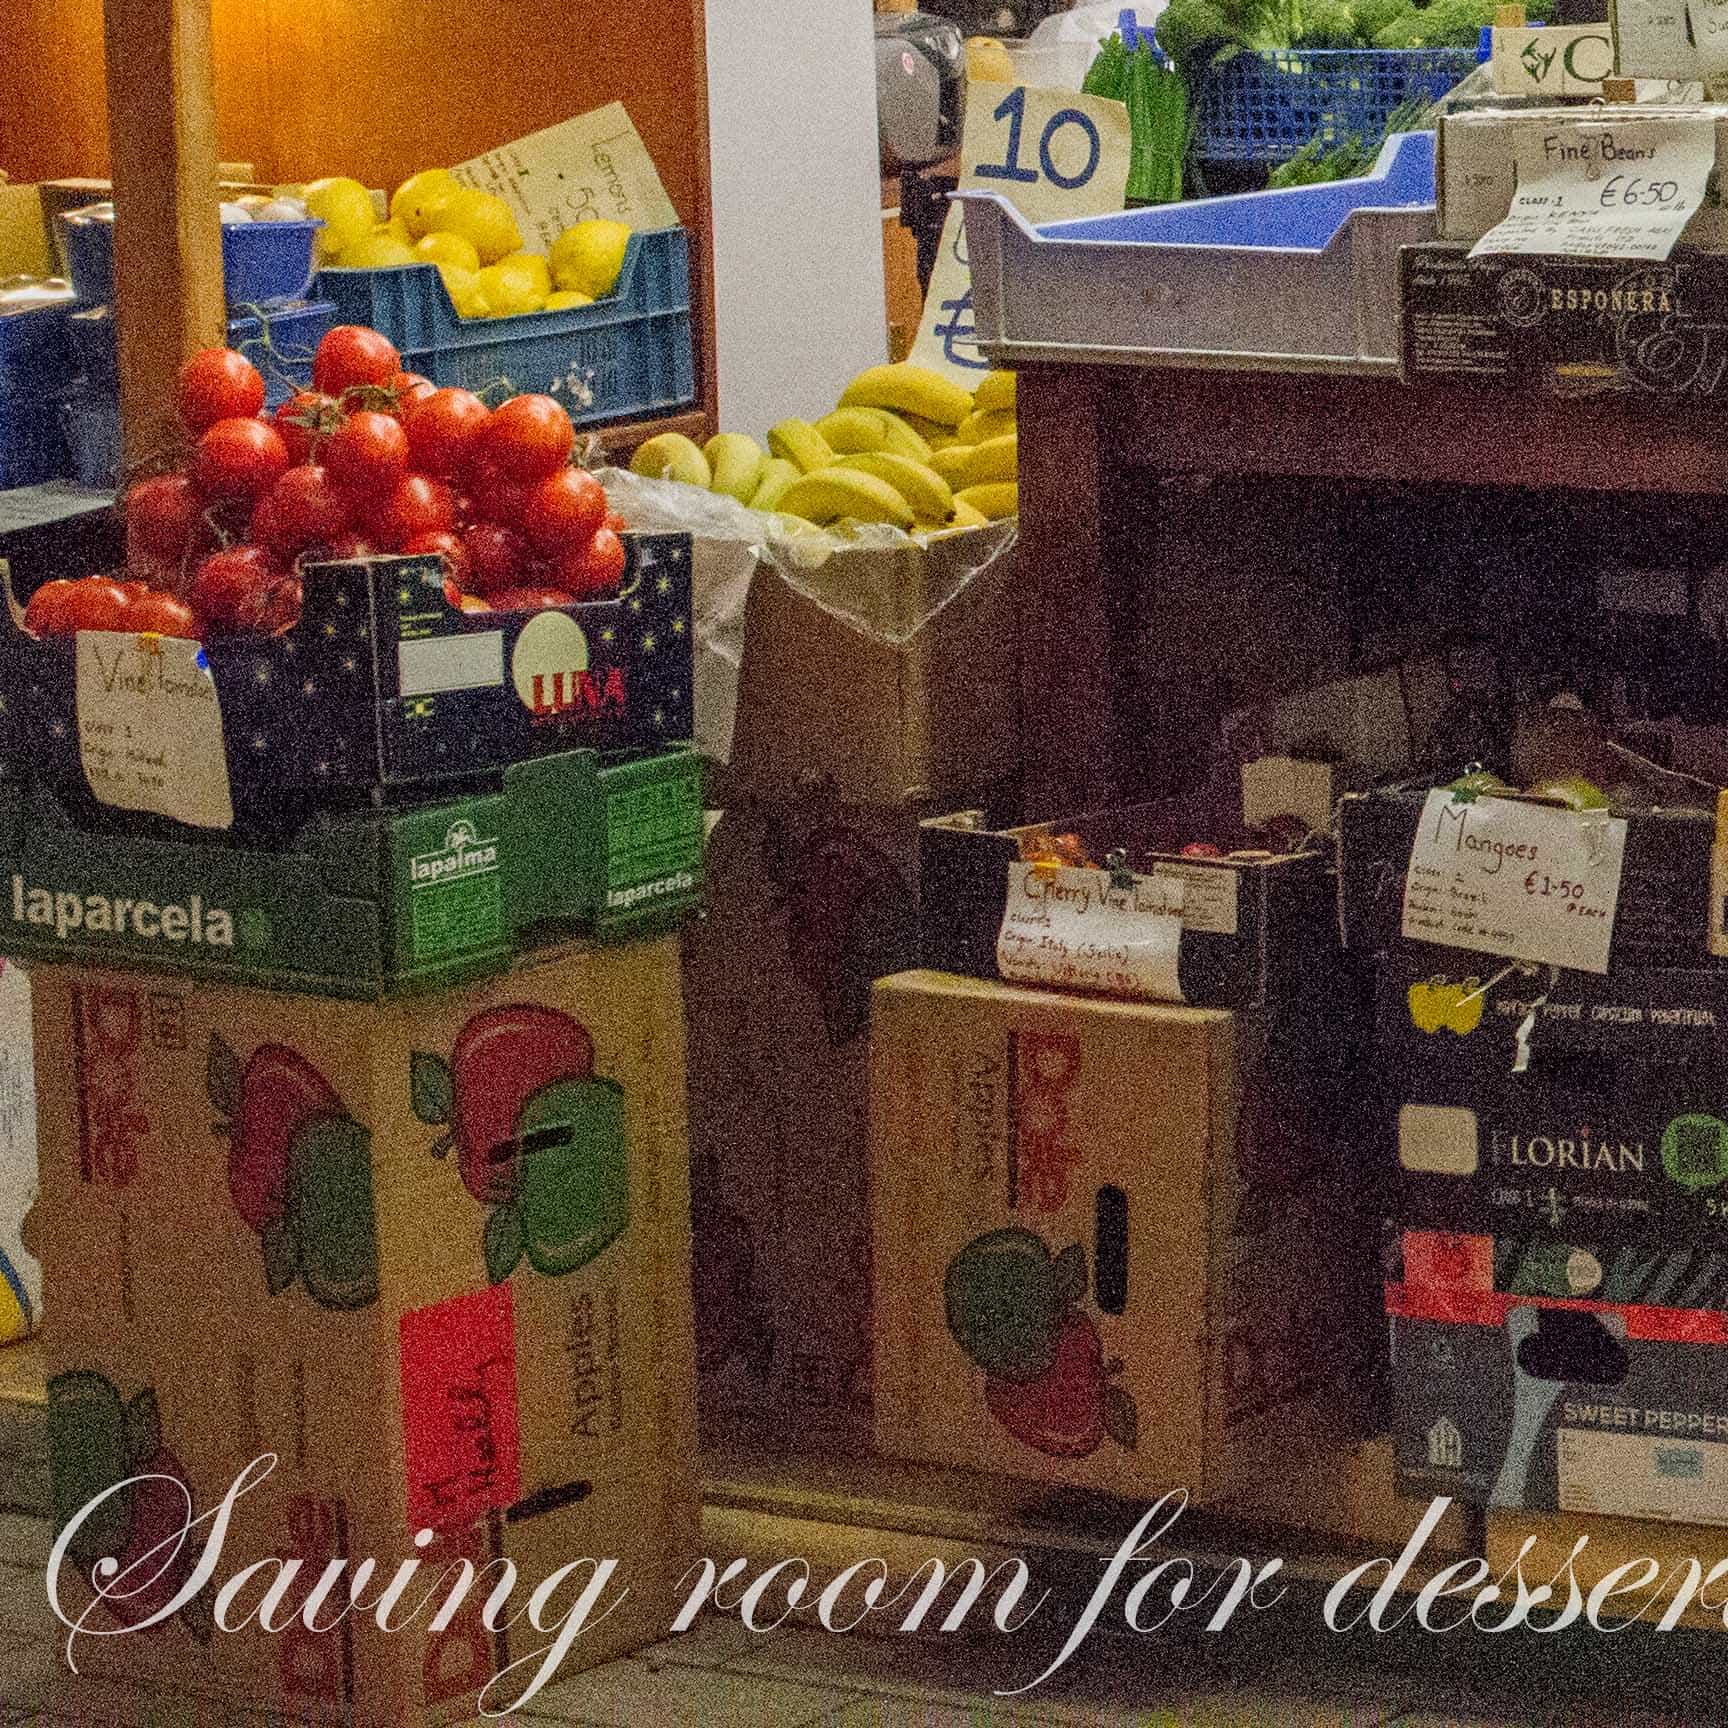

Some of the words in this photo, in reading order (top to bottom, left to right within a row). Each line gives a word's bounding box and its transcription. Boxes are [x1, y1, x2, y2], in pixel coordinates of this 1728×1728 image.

[973, 87, 1101, 191] 10
[1542, 132, 1590, 161] Fine
[1602, 133, 1656, 161] Beans
[1550, 287, 1673, 313] ESPONERA
[531, 666, 627, 715] LUNA
[409, 841, 499, 881] lapalma
[1433, 803, 1539, 876] Mangoes
[12, 877, 235, 948] laparcela
[607, 871, 693, 908] laparcela
[1023, 868, 1090, 915] Cherry
[566, 1291, 603, 1439] Apples
[1563, 1401, 1640, 1427] SWEET
